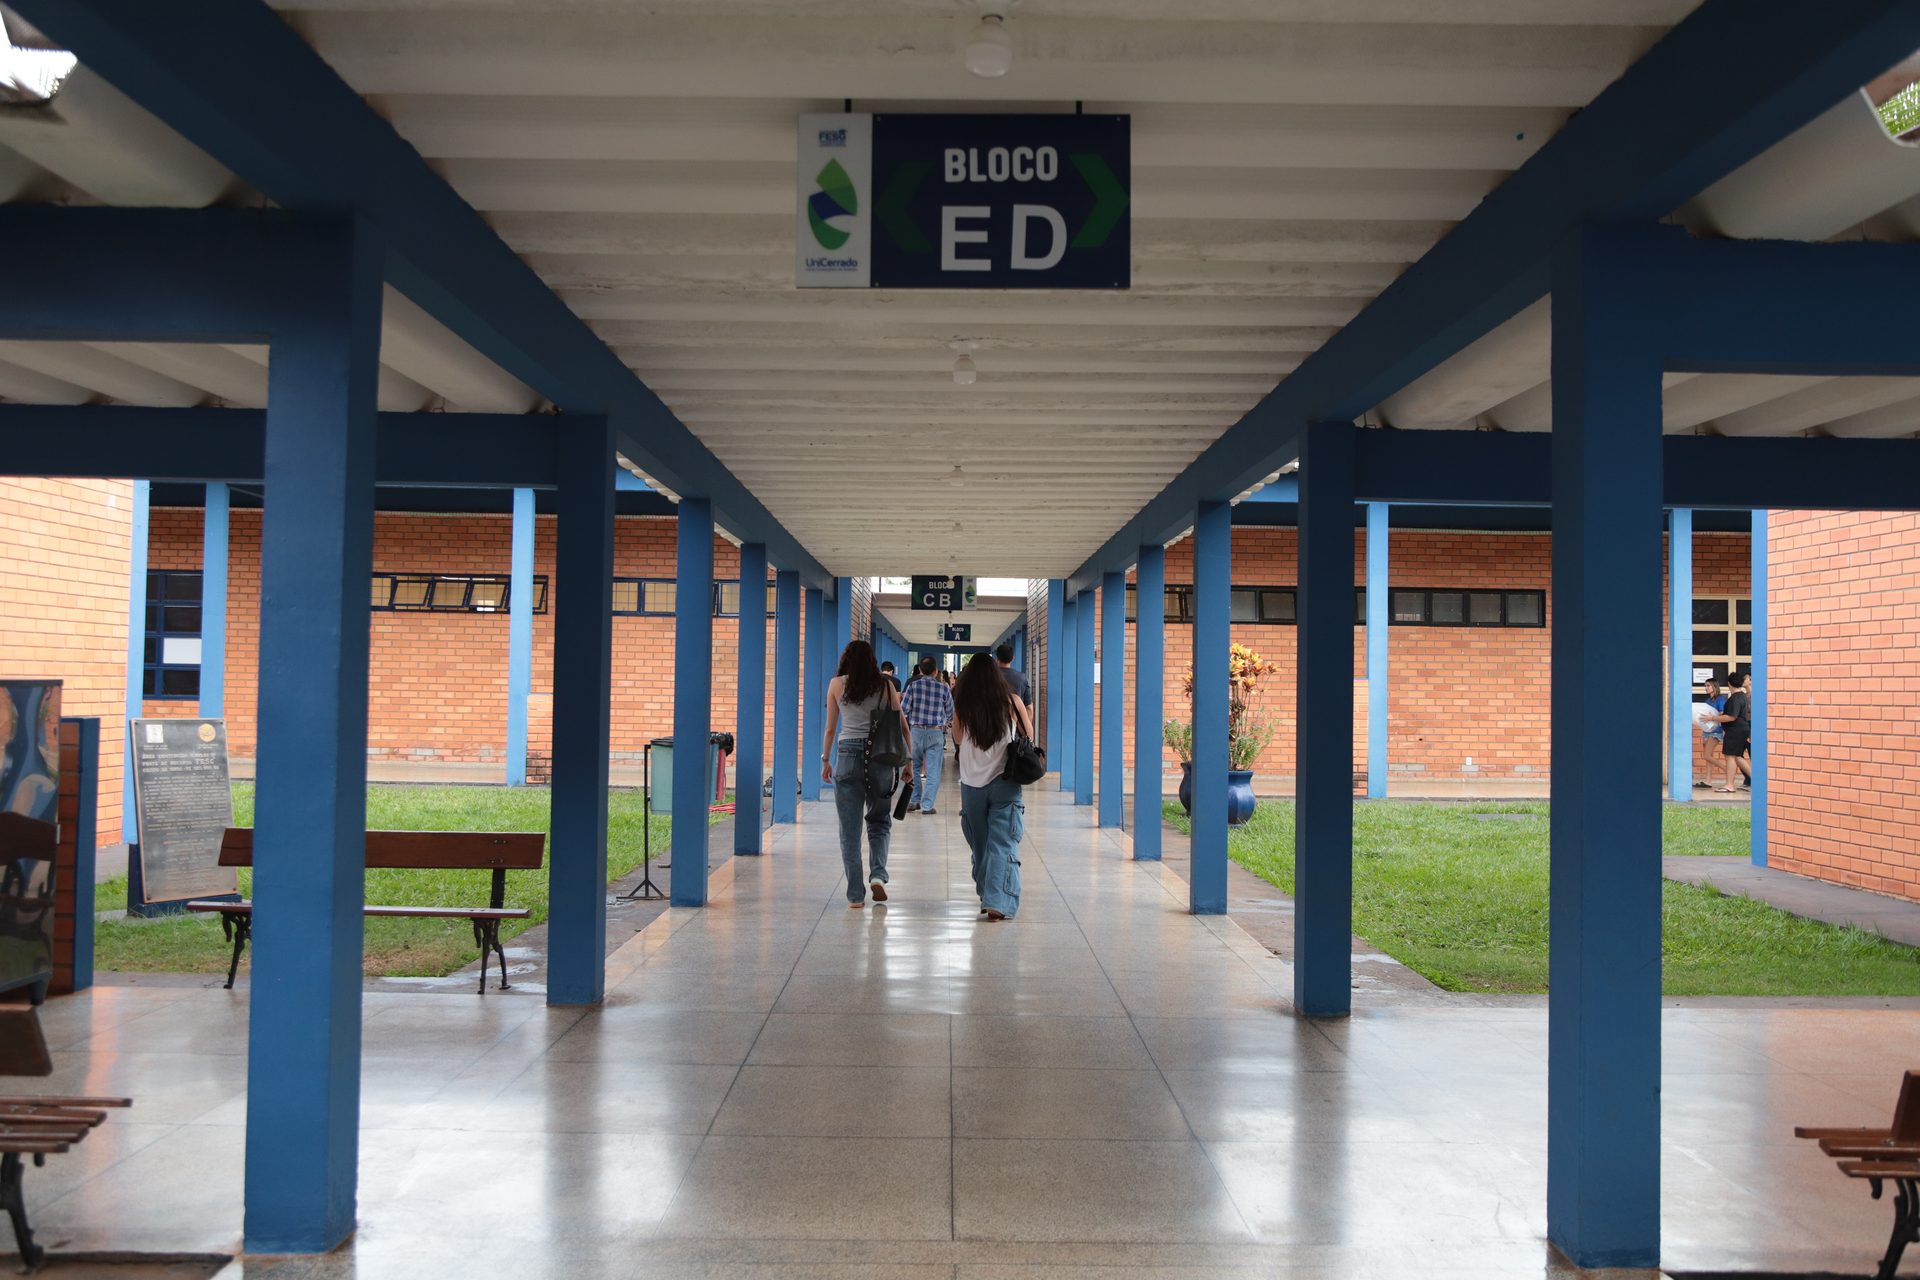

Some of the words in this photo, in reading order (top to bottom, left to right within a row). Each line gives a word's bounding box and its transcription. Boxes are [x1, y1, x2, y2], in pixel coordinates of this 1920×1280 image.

[944, 146, 1058, 183] BLOCO
[806, 257, 858, 267] UniCerrado
[929, 581, 952, 589] BLOC
